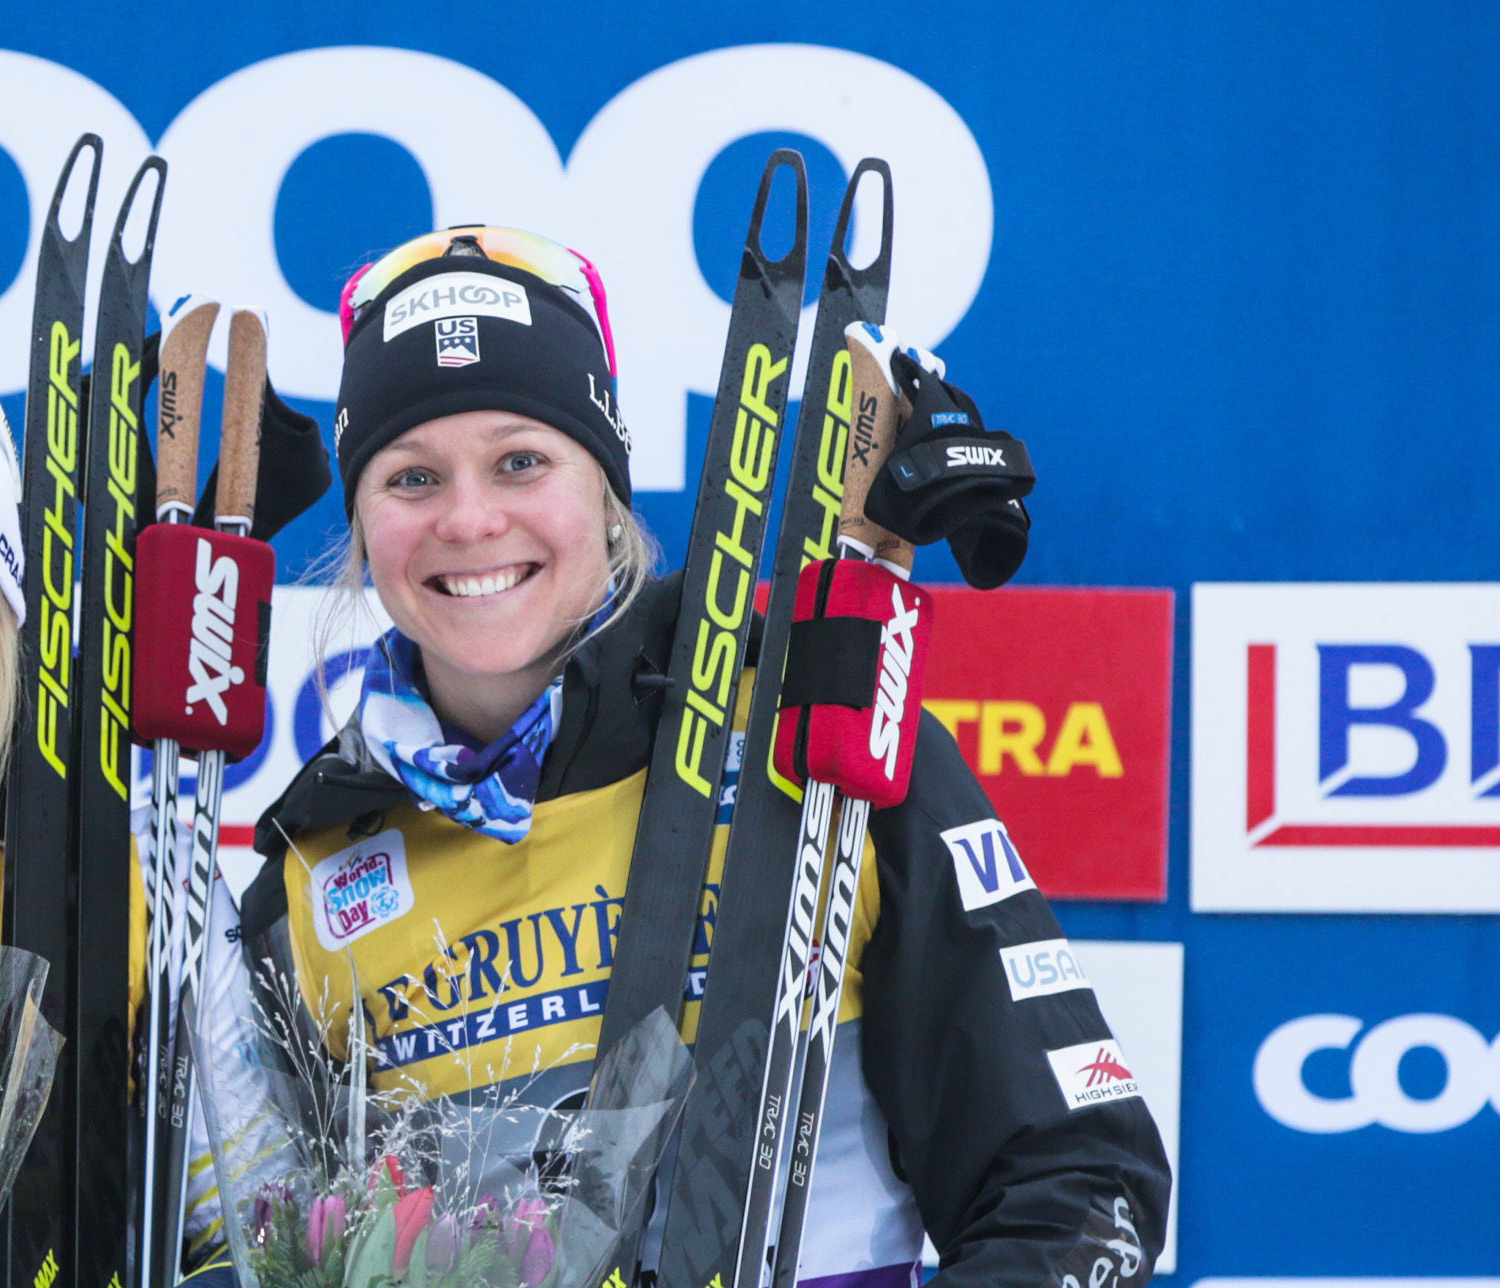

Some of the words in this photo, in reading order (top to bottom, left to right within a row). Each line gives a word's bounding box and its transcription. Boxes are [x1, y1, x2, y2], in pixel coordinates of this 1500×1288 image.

[390, 285, 523, 326] SKHOOP
[437, 319, 475, 336] US
[36, 320, 80, 779] FISCHER
[100, 342, 141, 802] FISCHER
[676, 343, 788, 798] FISCHER
[1009, 949, 1085, 989] USA
[1074, 1087, 1113, 1103] HIGH
[1252, 1012, 1500, 1134] coo
